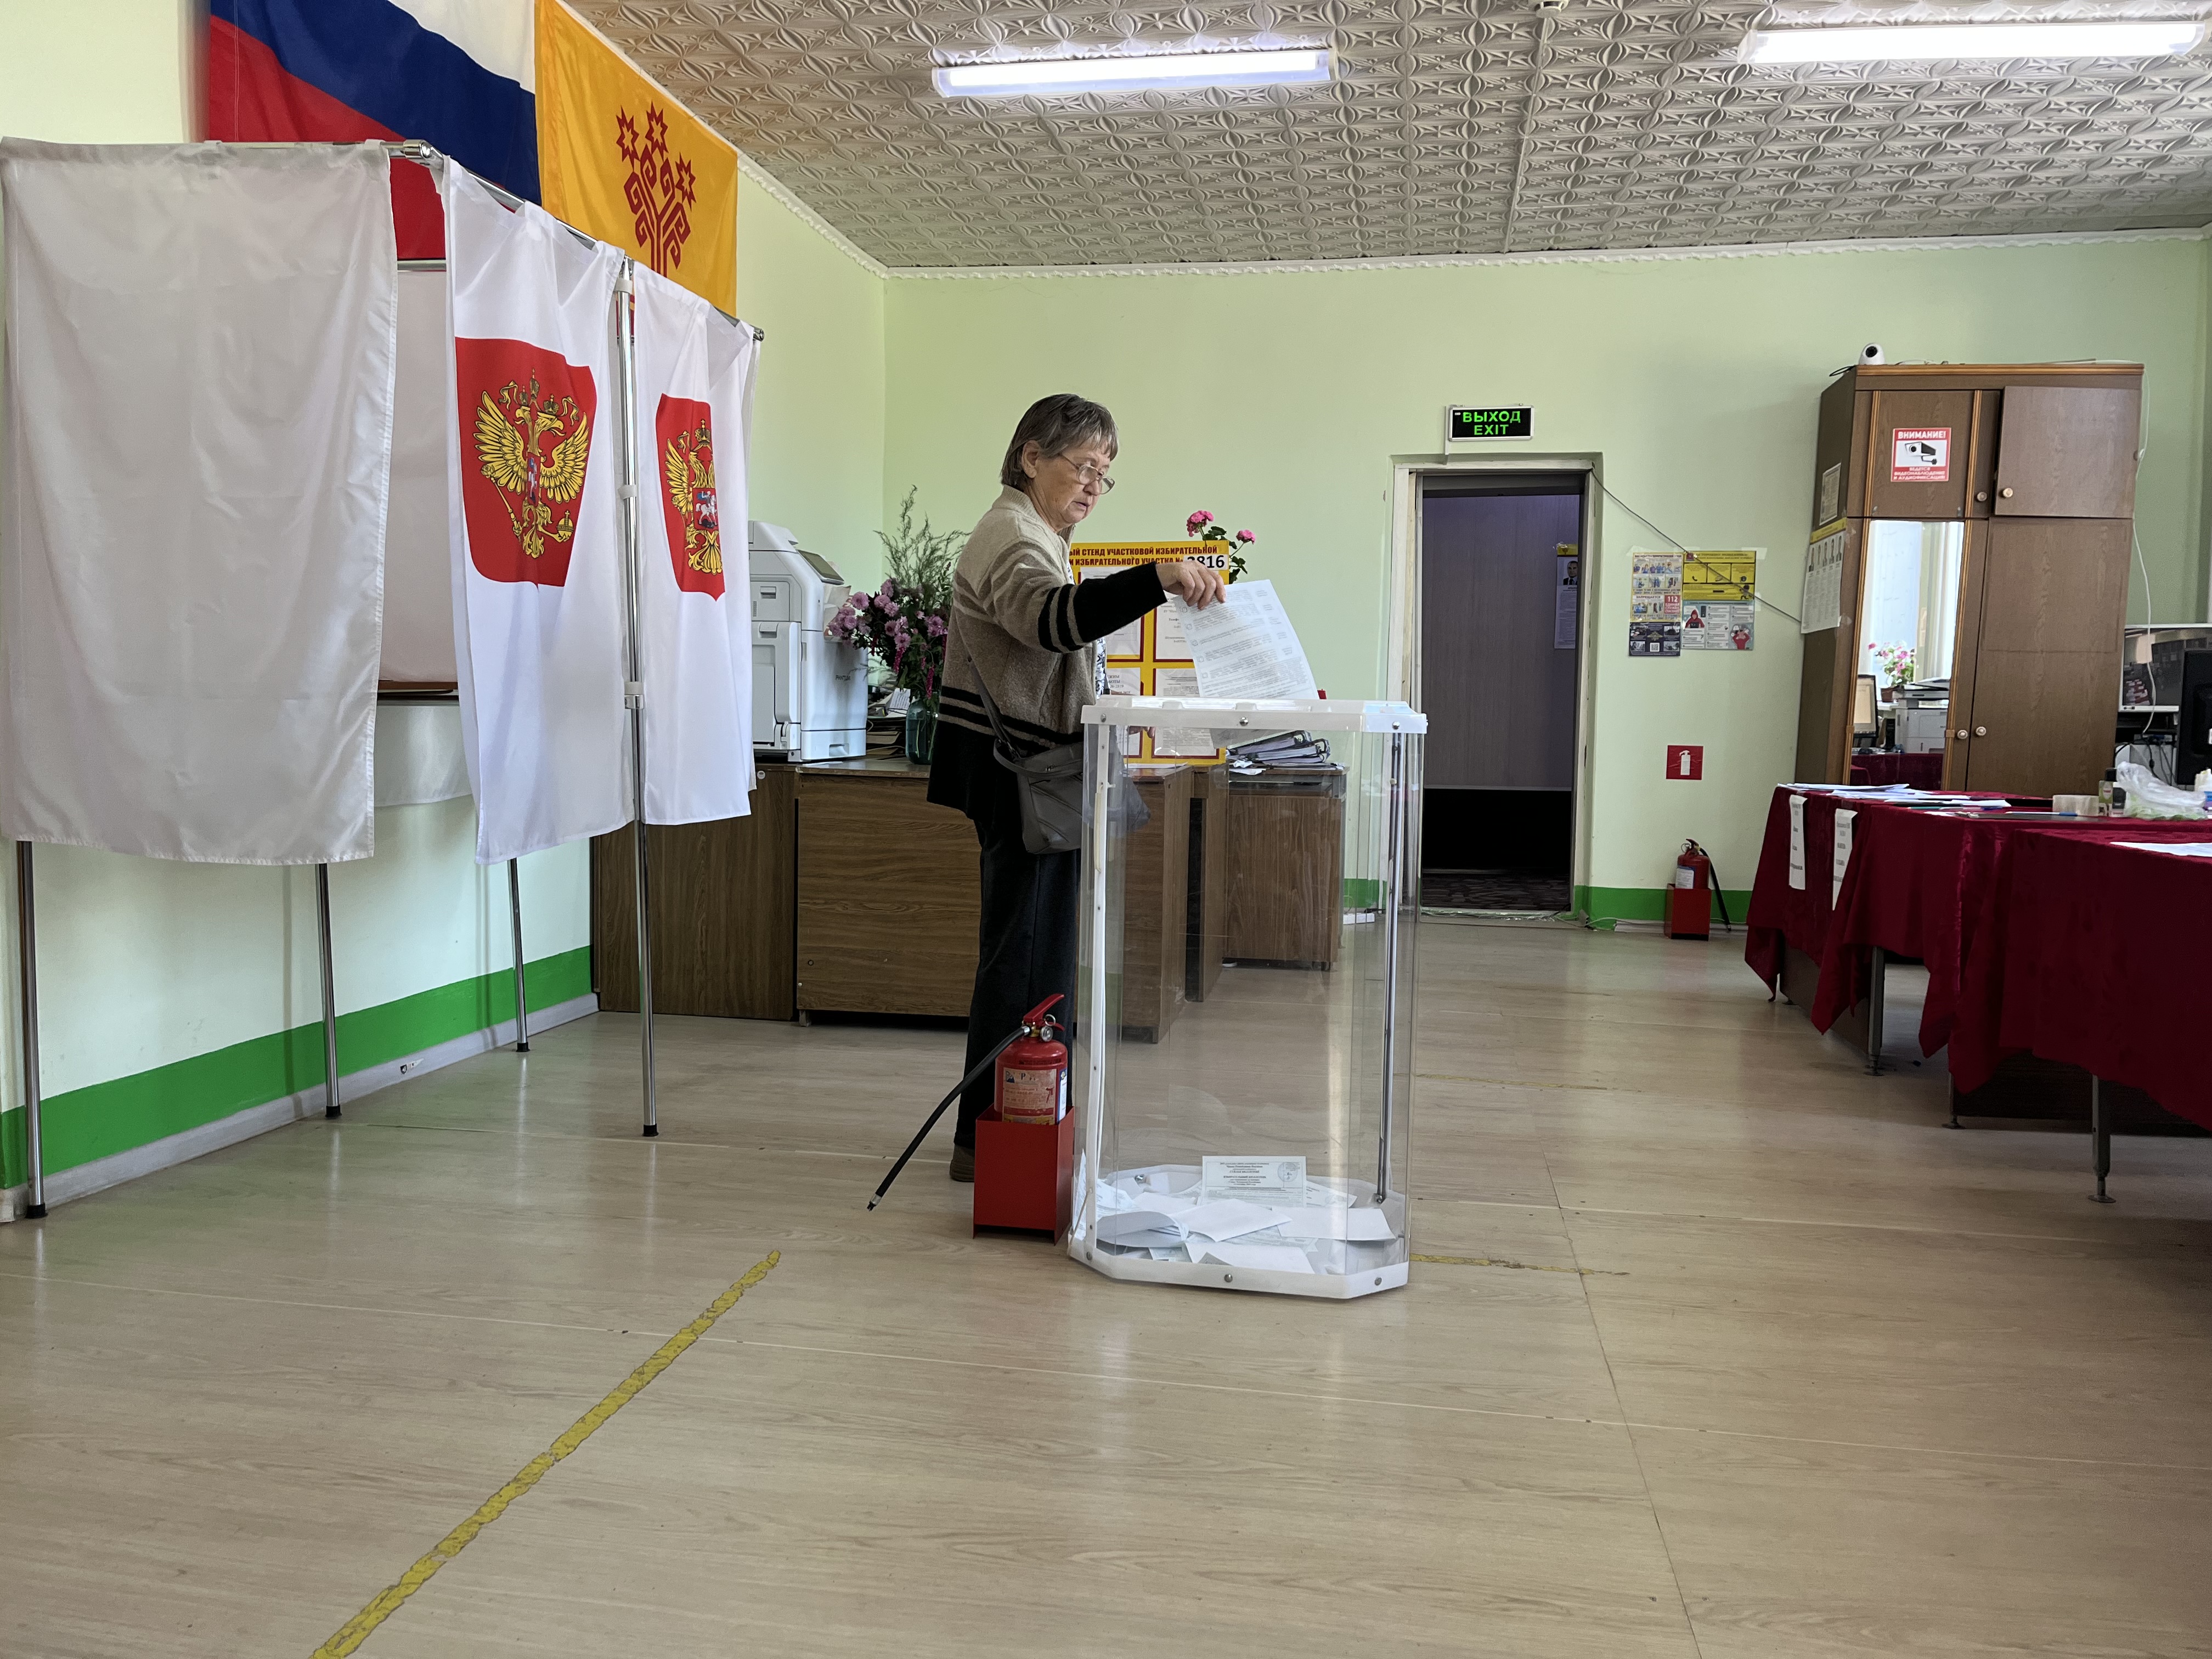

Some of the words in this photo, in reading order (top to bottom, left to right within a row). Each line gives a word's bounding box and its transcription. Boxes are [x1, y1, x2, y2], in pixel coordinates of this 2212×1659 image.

[1463, 411, 1521, 423] ВЫХОД
[1474, 424, 1509, 435] EXIT
[1898, 431, 1946, 439] ВНИМАНИЕ!
[1107, 547, 1154, 556] УЧАСТКОВОЙ
[1155, 545, 1217, 555] ИЗБИРАТЕЛЬНОЙ
